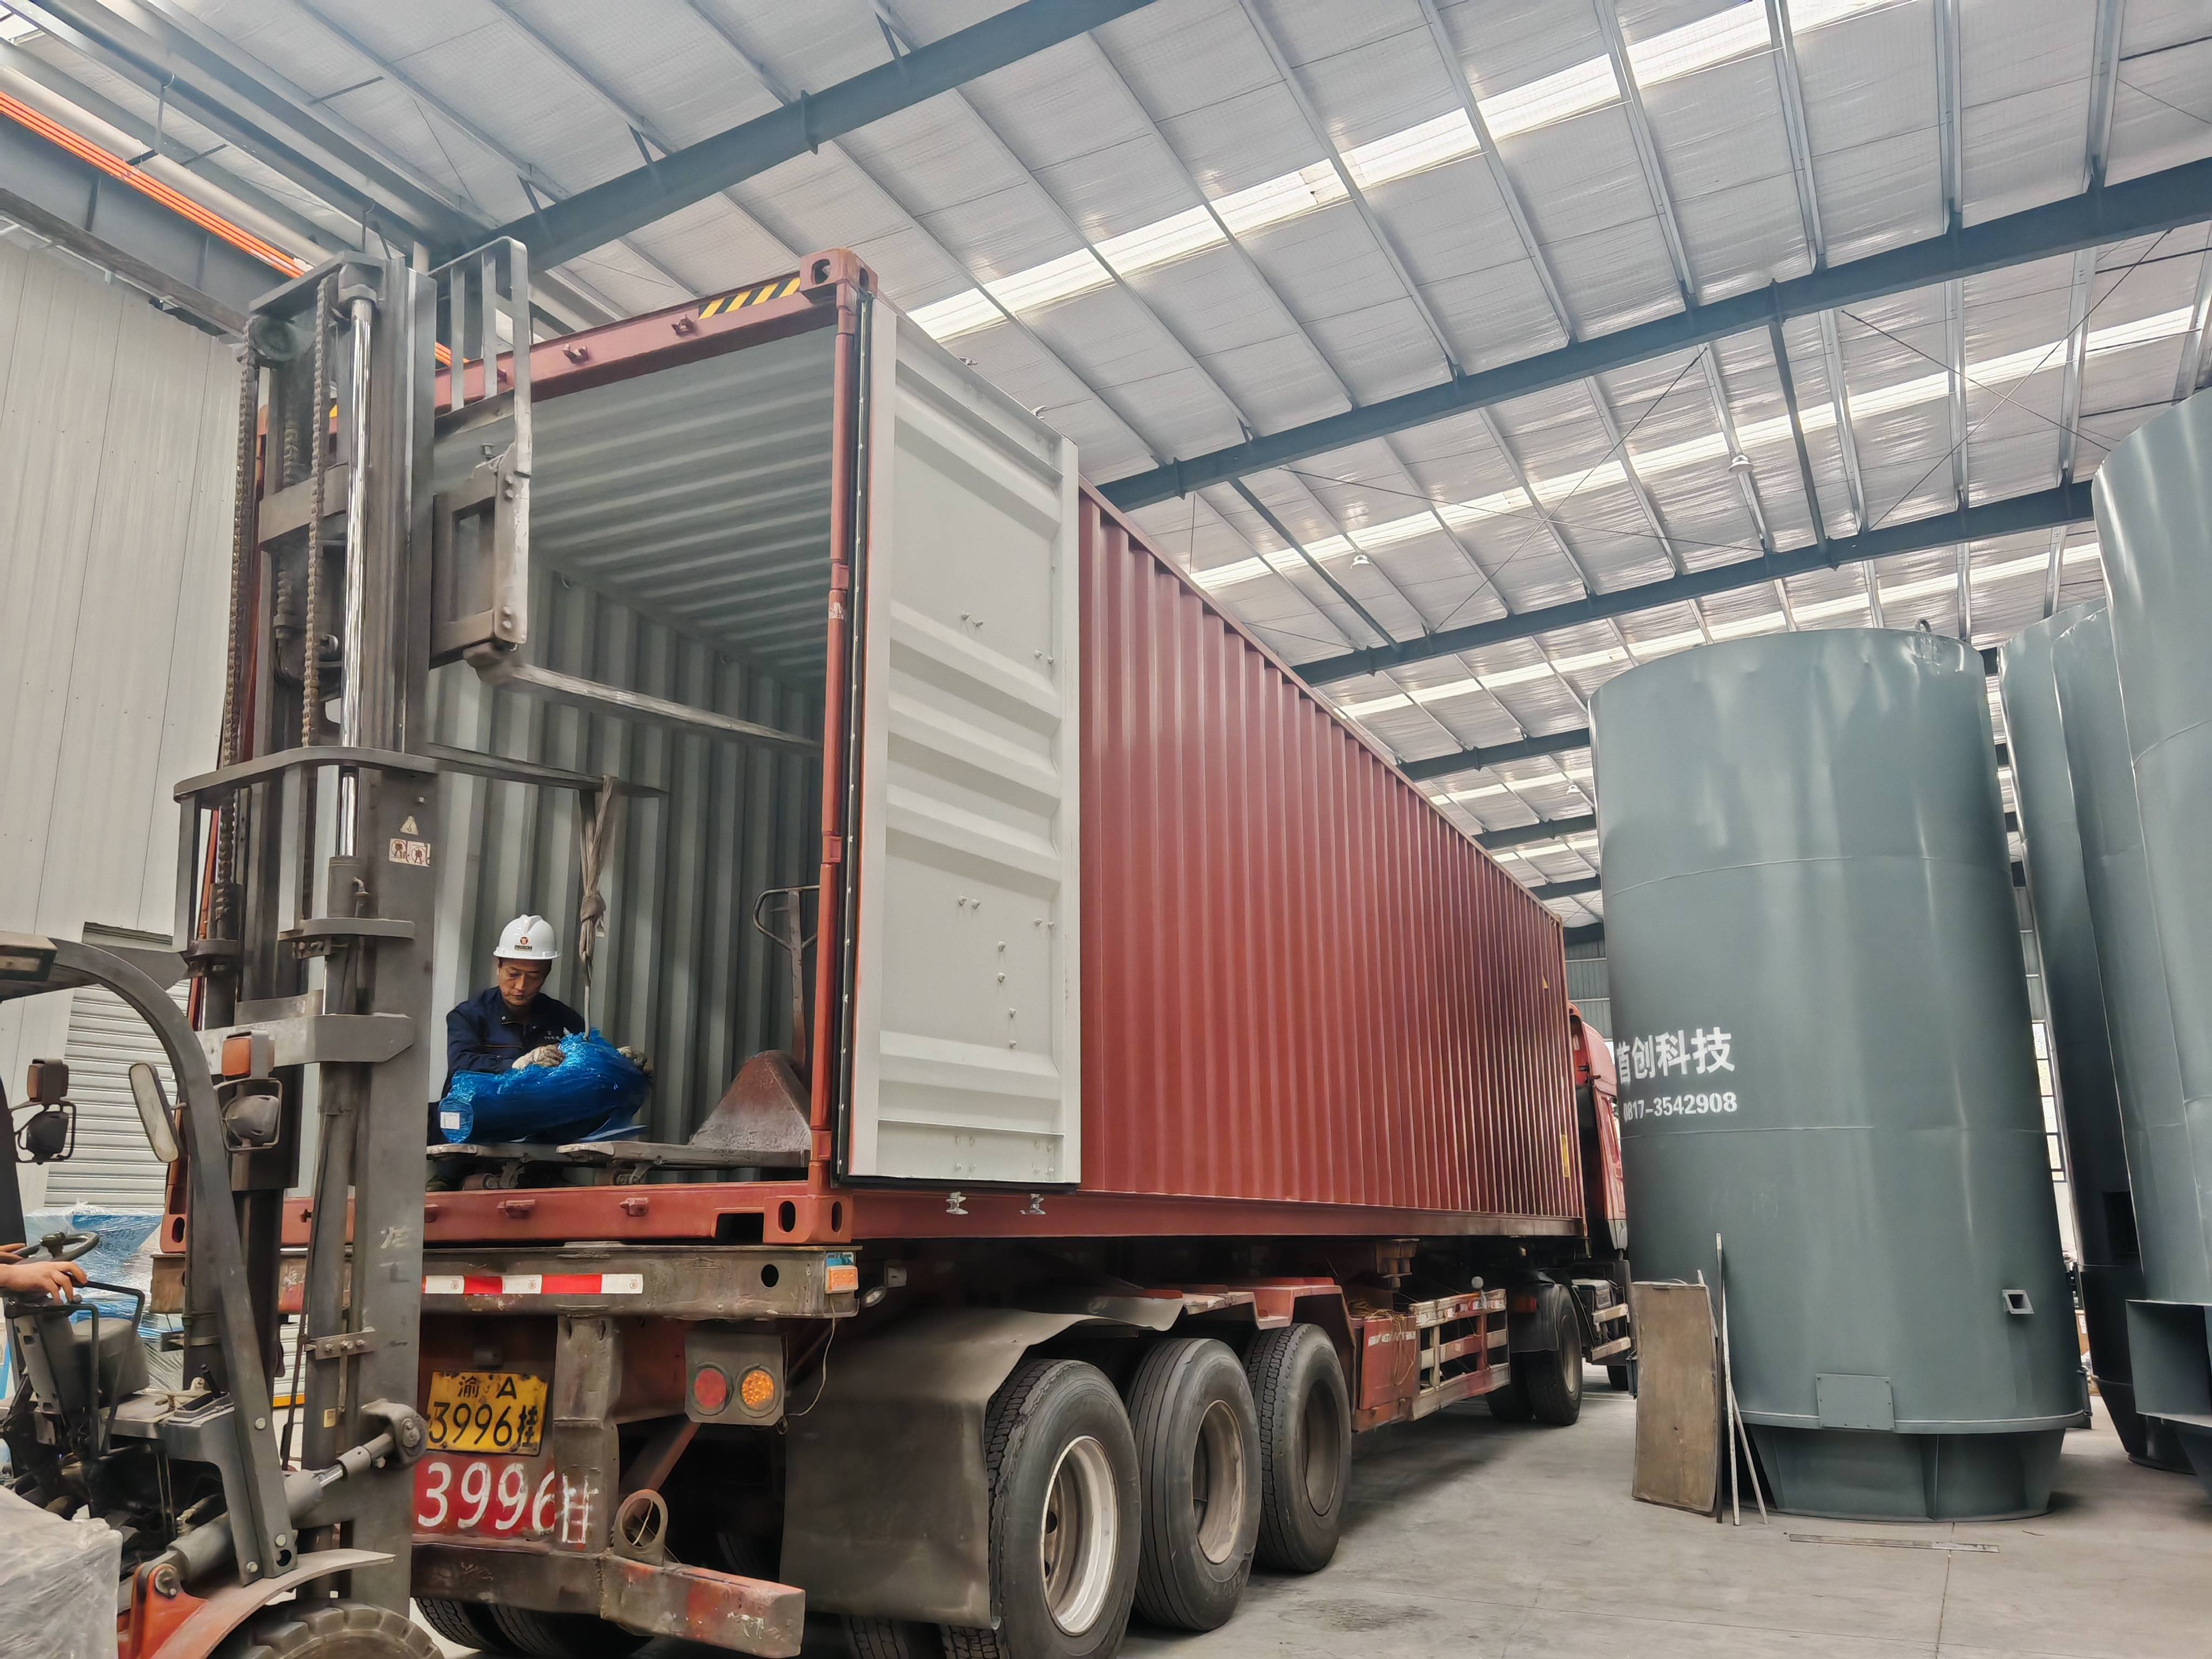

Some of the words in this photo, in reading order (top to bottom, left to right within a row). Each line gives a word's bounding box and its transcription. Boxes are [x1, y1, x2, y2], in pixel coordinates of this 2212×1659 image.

[1616, 1027, 1735, 1085] 首创科技
[1623, 1092, 1737, 1123] 0817-3542908
